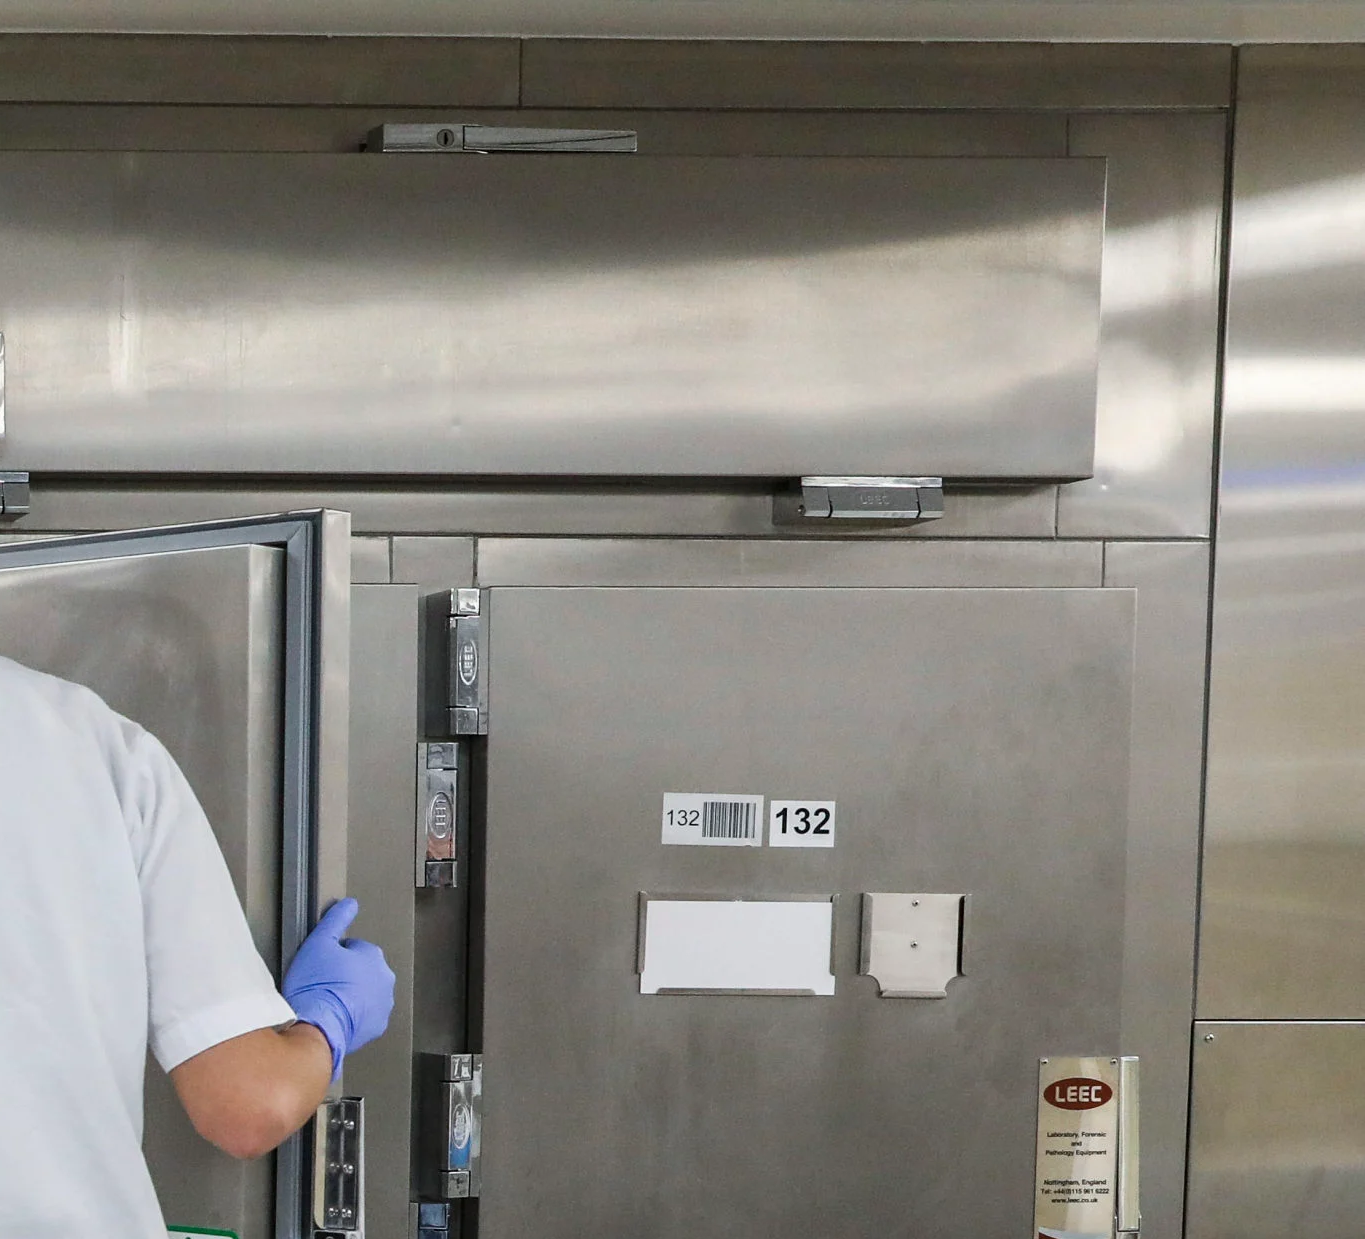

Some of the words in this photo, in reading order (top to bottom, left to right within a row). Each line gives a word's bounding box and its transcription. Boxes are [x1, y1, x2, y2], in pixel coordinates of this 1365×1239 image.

[666, 809, 700, 826] 132
[775, 807, 831, 835] 132
[1055, 1085, 1102, 1103] LEEC
